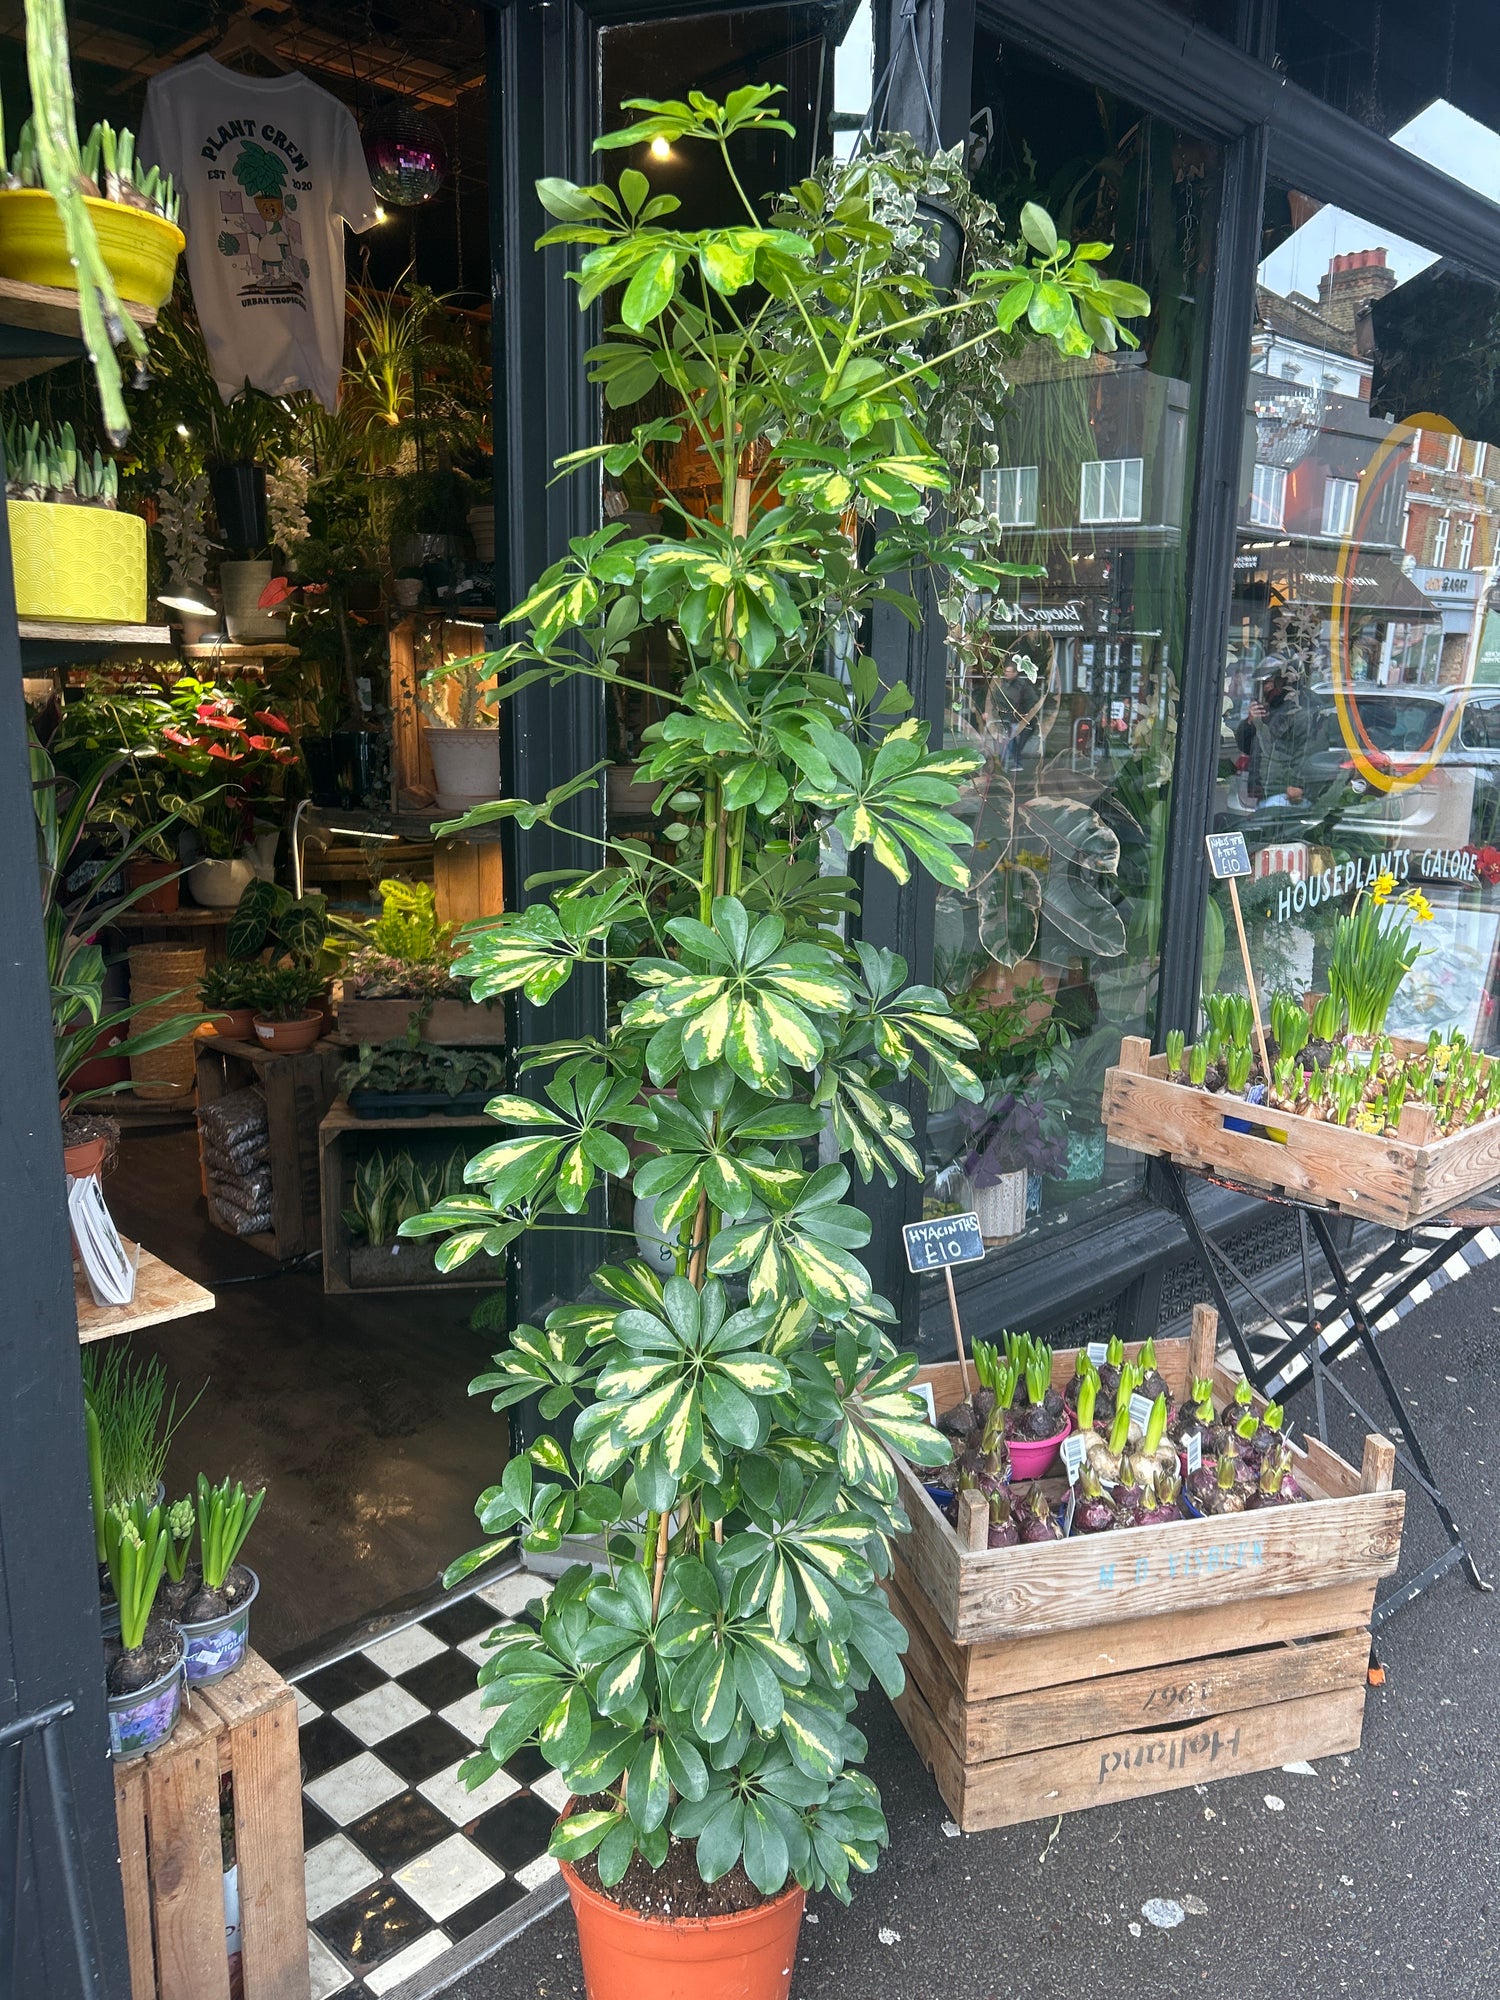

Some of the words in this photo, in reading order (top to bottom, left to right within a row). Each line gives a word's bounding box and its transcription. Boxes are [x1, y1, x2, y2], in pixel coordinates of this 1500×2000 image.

[201, 120, 256, 162] PLANT
[261, 124, 309, 173] CREW
[207, 169, 226, 180] EST
[292, 178, 313, 191] 2020
[241, 297, 269, 308] URBAN
[1222, 857, 1241, 874] £10
[1278, 848, 1411, 923] HOUSEPLANTS
[1421, 847, 1477, 882] GALORE
[908, 1215, 979, 1244] HYACINTHS
[924, 1240, 962, 1264] £10
[1098, 1727, 1240, 1784] Holland
